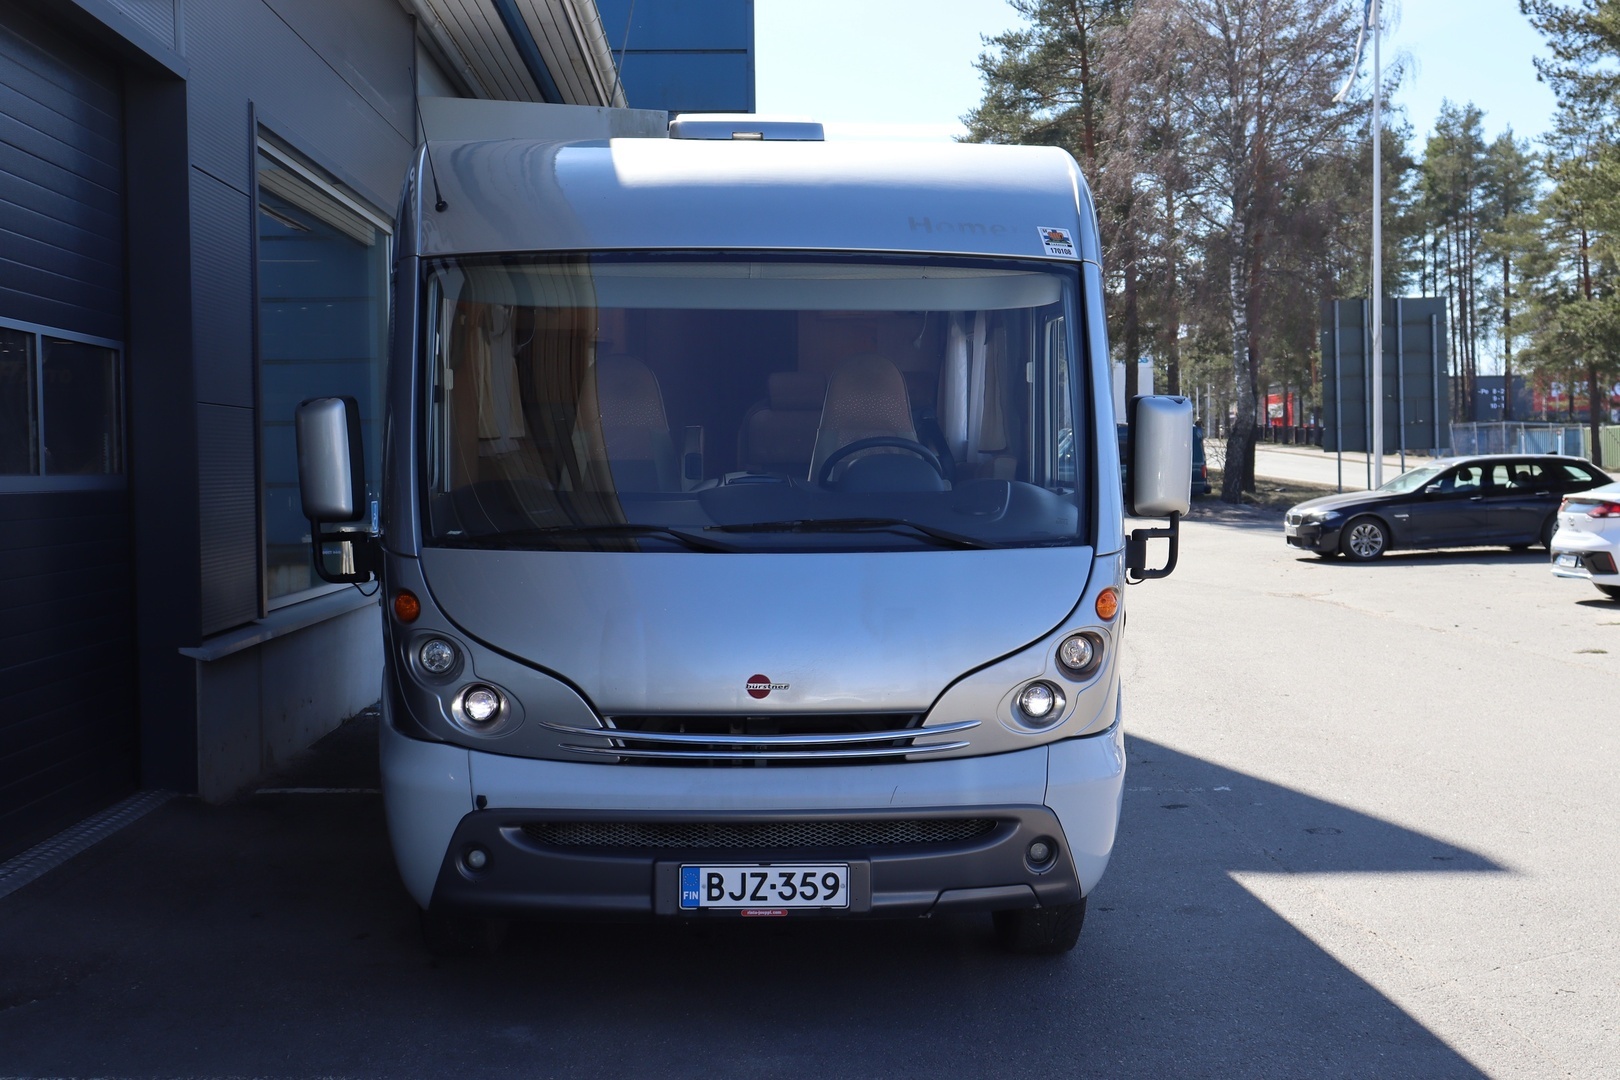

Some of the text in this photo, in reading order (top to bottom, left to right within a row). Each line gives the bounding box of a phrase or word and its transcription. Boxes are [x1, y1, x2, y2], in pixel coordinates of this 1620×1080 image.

[908, 216, 1006, 235] Home
[683, 891, 699, 900] FIN
[707, 872, 840, 901] BJZ-359
